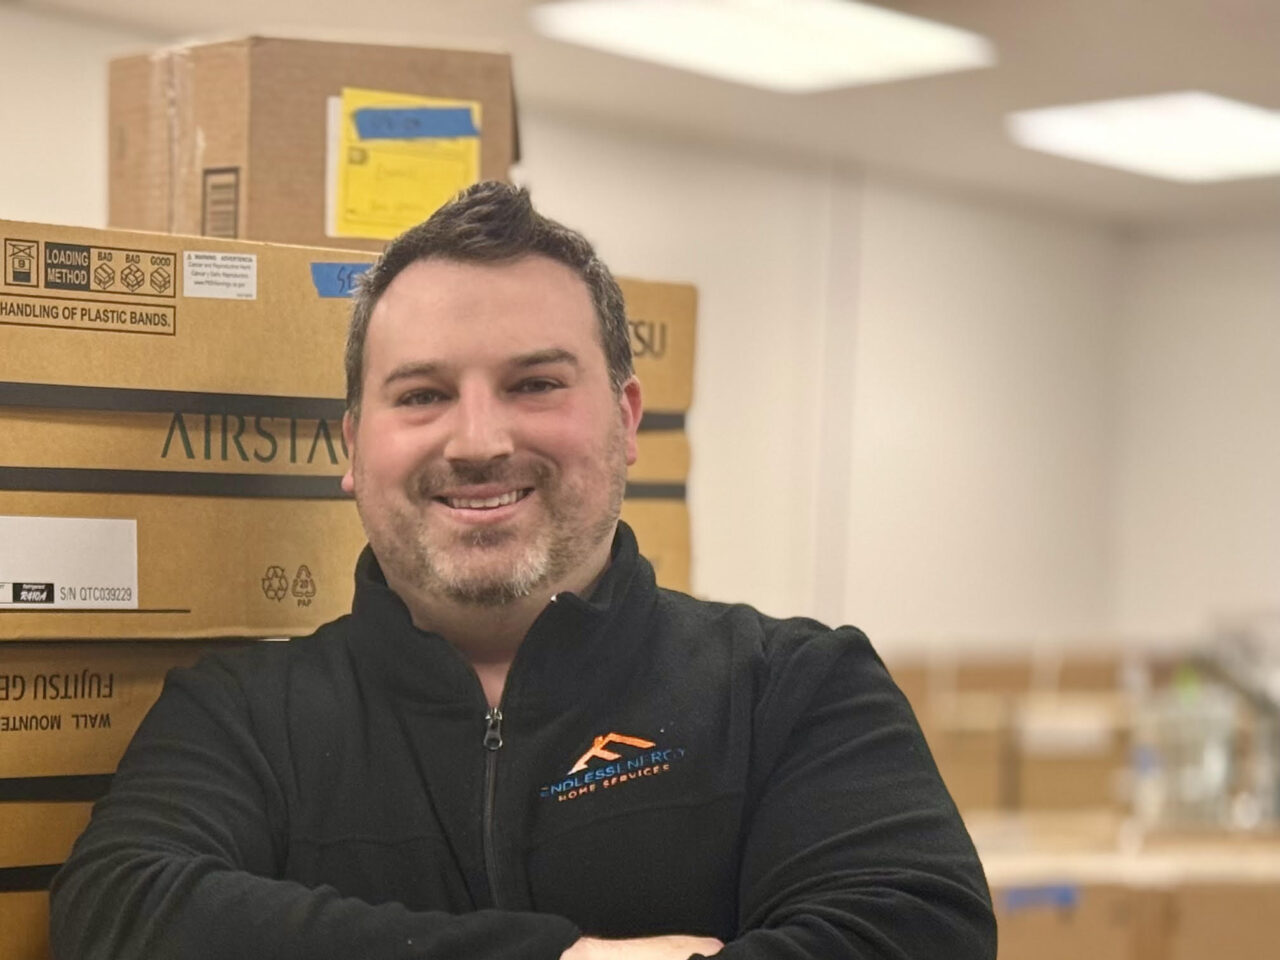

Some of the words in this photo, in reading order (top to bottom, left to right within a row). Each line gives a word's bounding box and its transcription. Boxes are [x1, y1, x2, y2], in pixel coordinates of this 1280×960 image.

[46, 248, 89, 266] LOADING
[97, 251, 113, 262] BAD
[125, 254, 140, 264] BAD
[150, 256, 171, 266] GOOD
[47, 267, 88, 285] METHOD
[0, 303, 60, 321] HANDLING
[62, 307, 78, 322] OF
[80, 308, 128, 326] PLASTIC
[129, 311, 171, 328] BANDS.
[60, 586, 77, 601] S/N
[79, 586, 132, 602] QTC039229
[297, 599, 313, 608] PAP
[34, 669, 114, 700] FUJITSU
[72, 713, 111, 730] WALL
[558, 783, 596, 802] HOME
